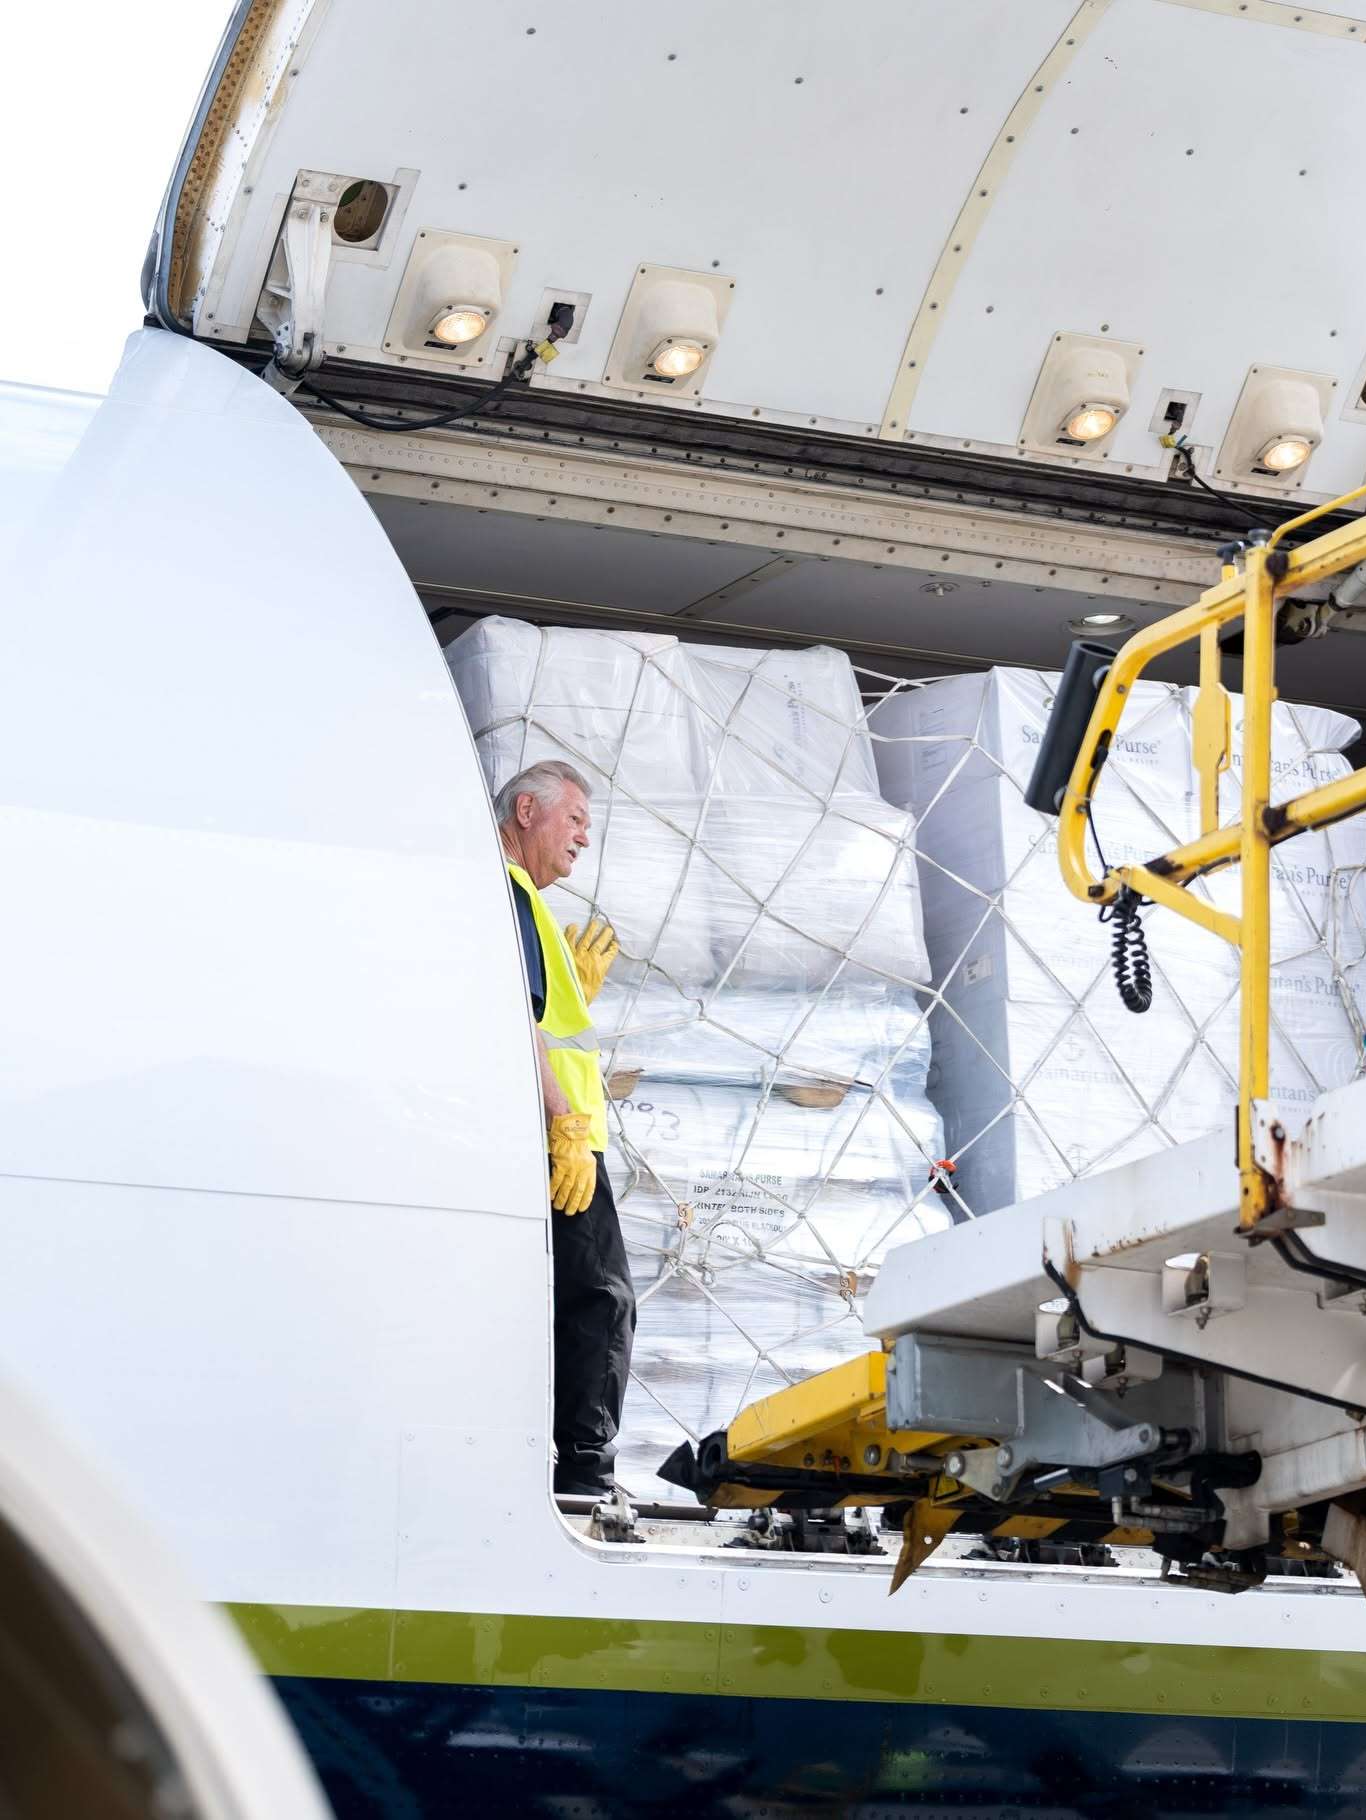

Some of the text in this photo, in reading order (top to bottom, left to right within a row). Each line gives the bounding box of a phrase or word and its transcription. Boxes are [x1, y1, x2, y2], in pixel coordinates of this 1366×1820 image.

[1115, 735, 1158, 755] Purse
[1307, 867, 1347, 889] Pure
[755, 1173, 783, 1186] PURSE
[694, 1201, 785, 1218] RINTE BOTH SIDES
